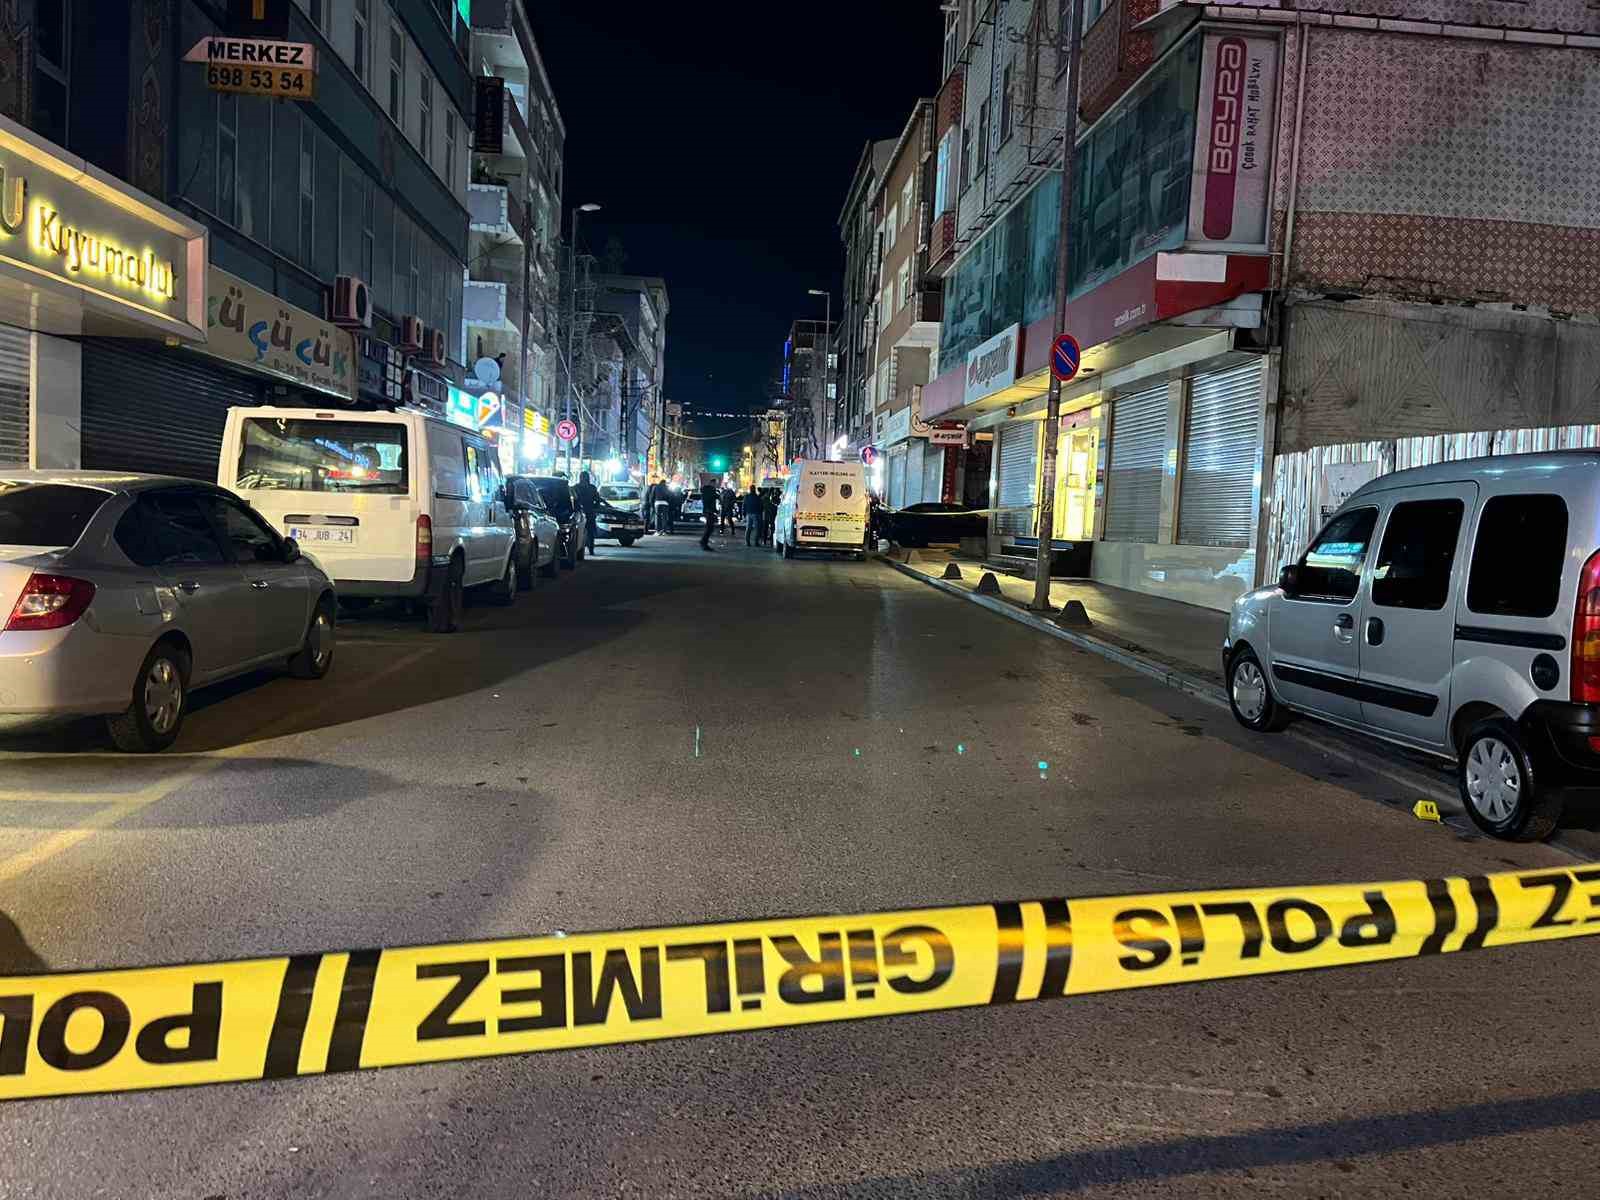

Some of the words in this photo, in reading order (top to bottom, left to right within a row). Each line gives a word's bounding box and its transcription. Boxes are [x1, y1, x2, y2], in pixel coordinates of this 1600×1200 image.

[207, 41, 304, 64] MERKEZ
[208, 66, 243, 86] 698
[249, 70, 273, 89] 53
[280, 72, 304, 91] 54
[1112, 891, 1397, 972] POLİS
[416, 925, 956, 1043] GİRİLMEZ
